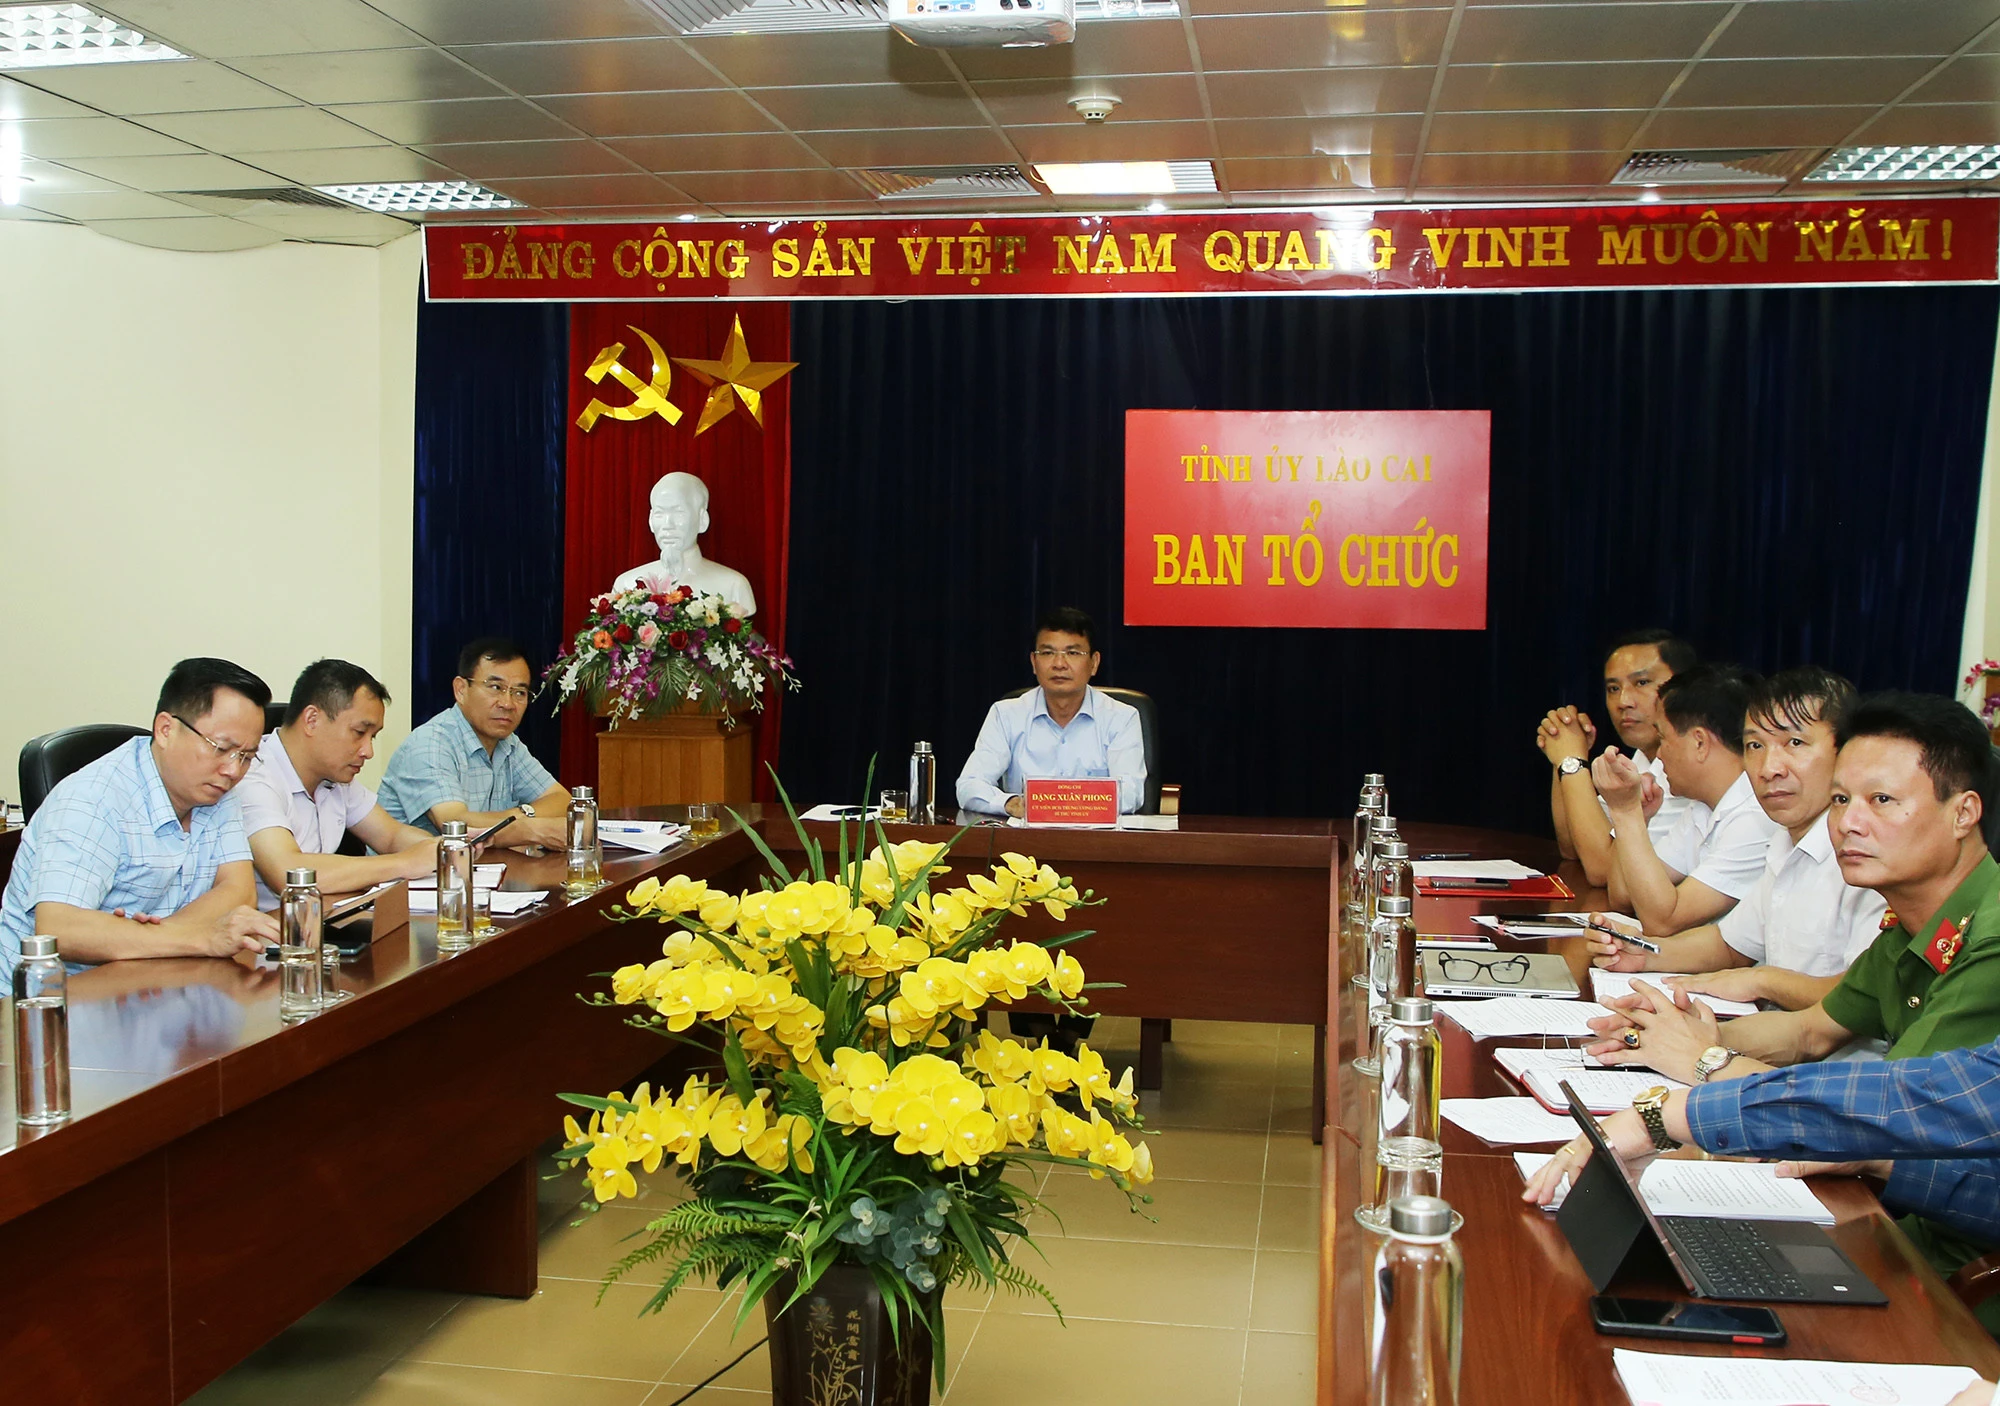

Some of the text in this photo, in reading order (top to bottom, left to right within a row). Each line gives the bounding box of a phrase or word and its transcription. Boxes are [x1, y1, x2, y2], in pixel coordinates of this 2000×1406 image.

[460, 225, 596, 280] ĐẢNG
[612, 226, 750, 292] CỘNG
[771, 220, 876, 278] SẢN
[897, 221, 1027, 286] VIỆT
[1052, 232, 1178, 274] NAM
[1203, 228, 1397, 274] QUANG
[1421, 226, 1571, 269] VINH
[1596, 209, 1774, 265] MUÔN
[1180, 444, 1433, 483] TỈNH ỦY LÀO CAI
[1153, 499, 1459, 588] BAN TỔ CHỨC
[1057, 792, 1081, 801] XUÂN
[1082, 794, 1113, 802] PHONG
